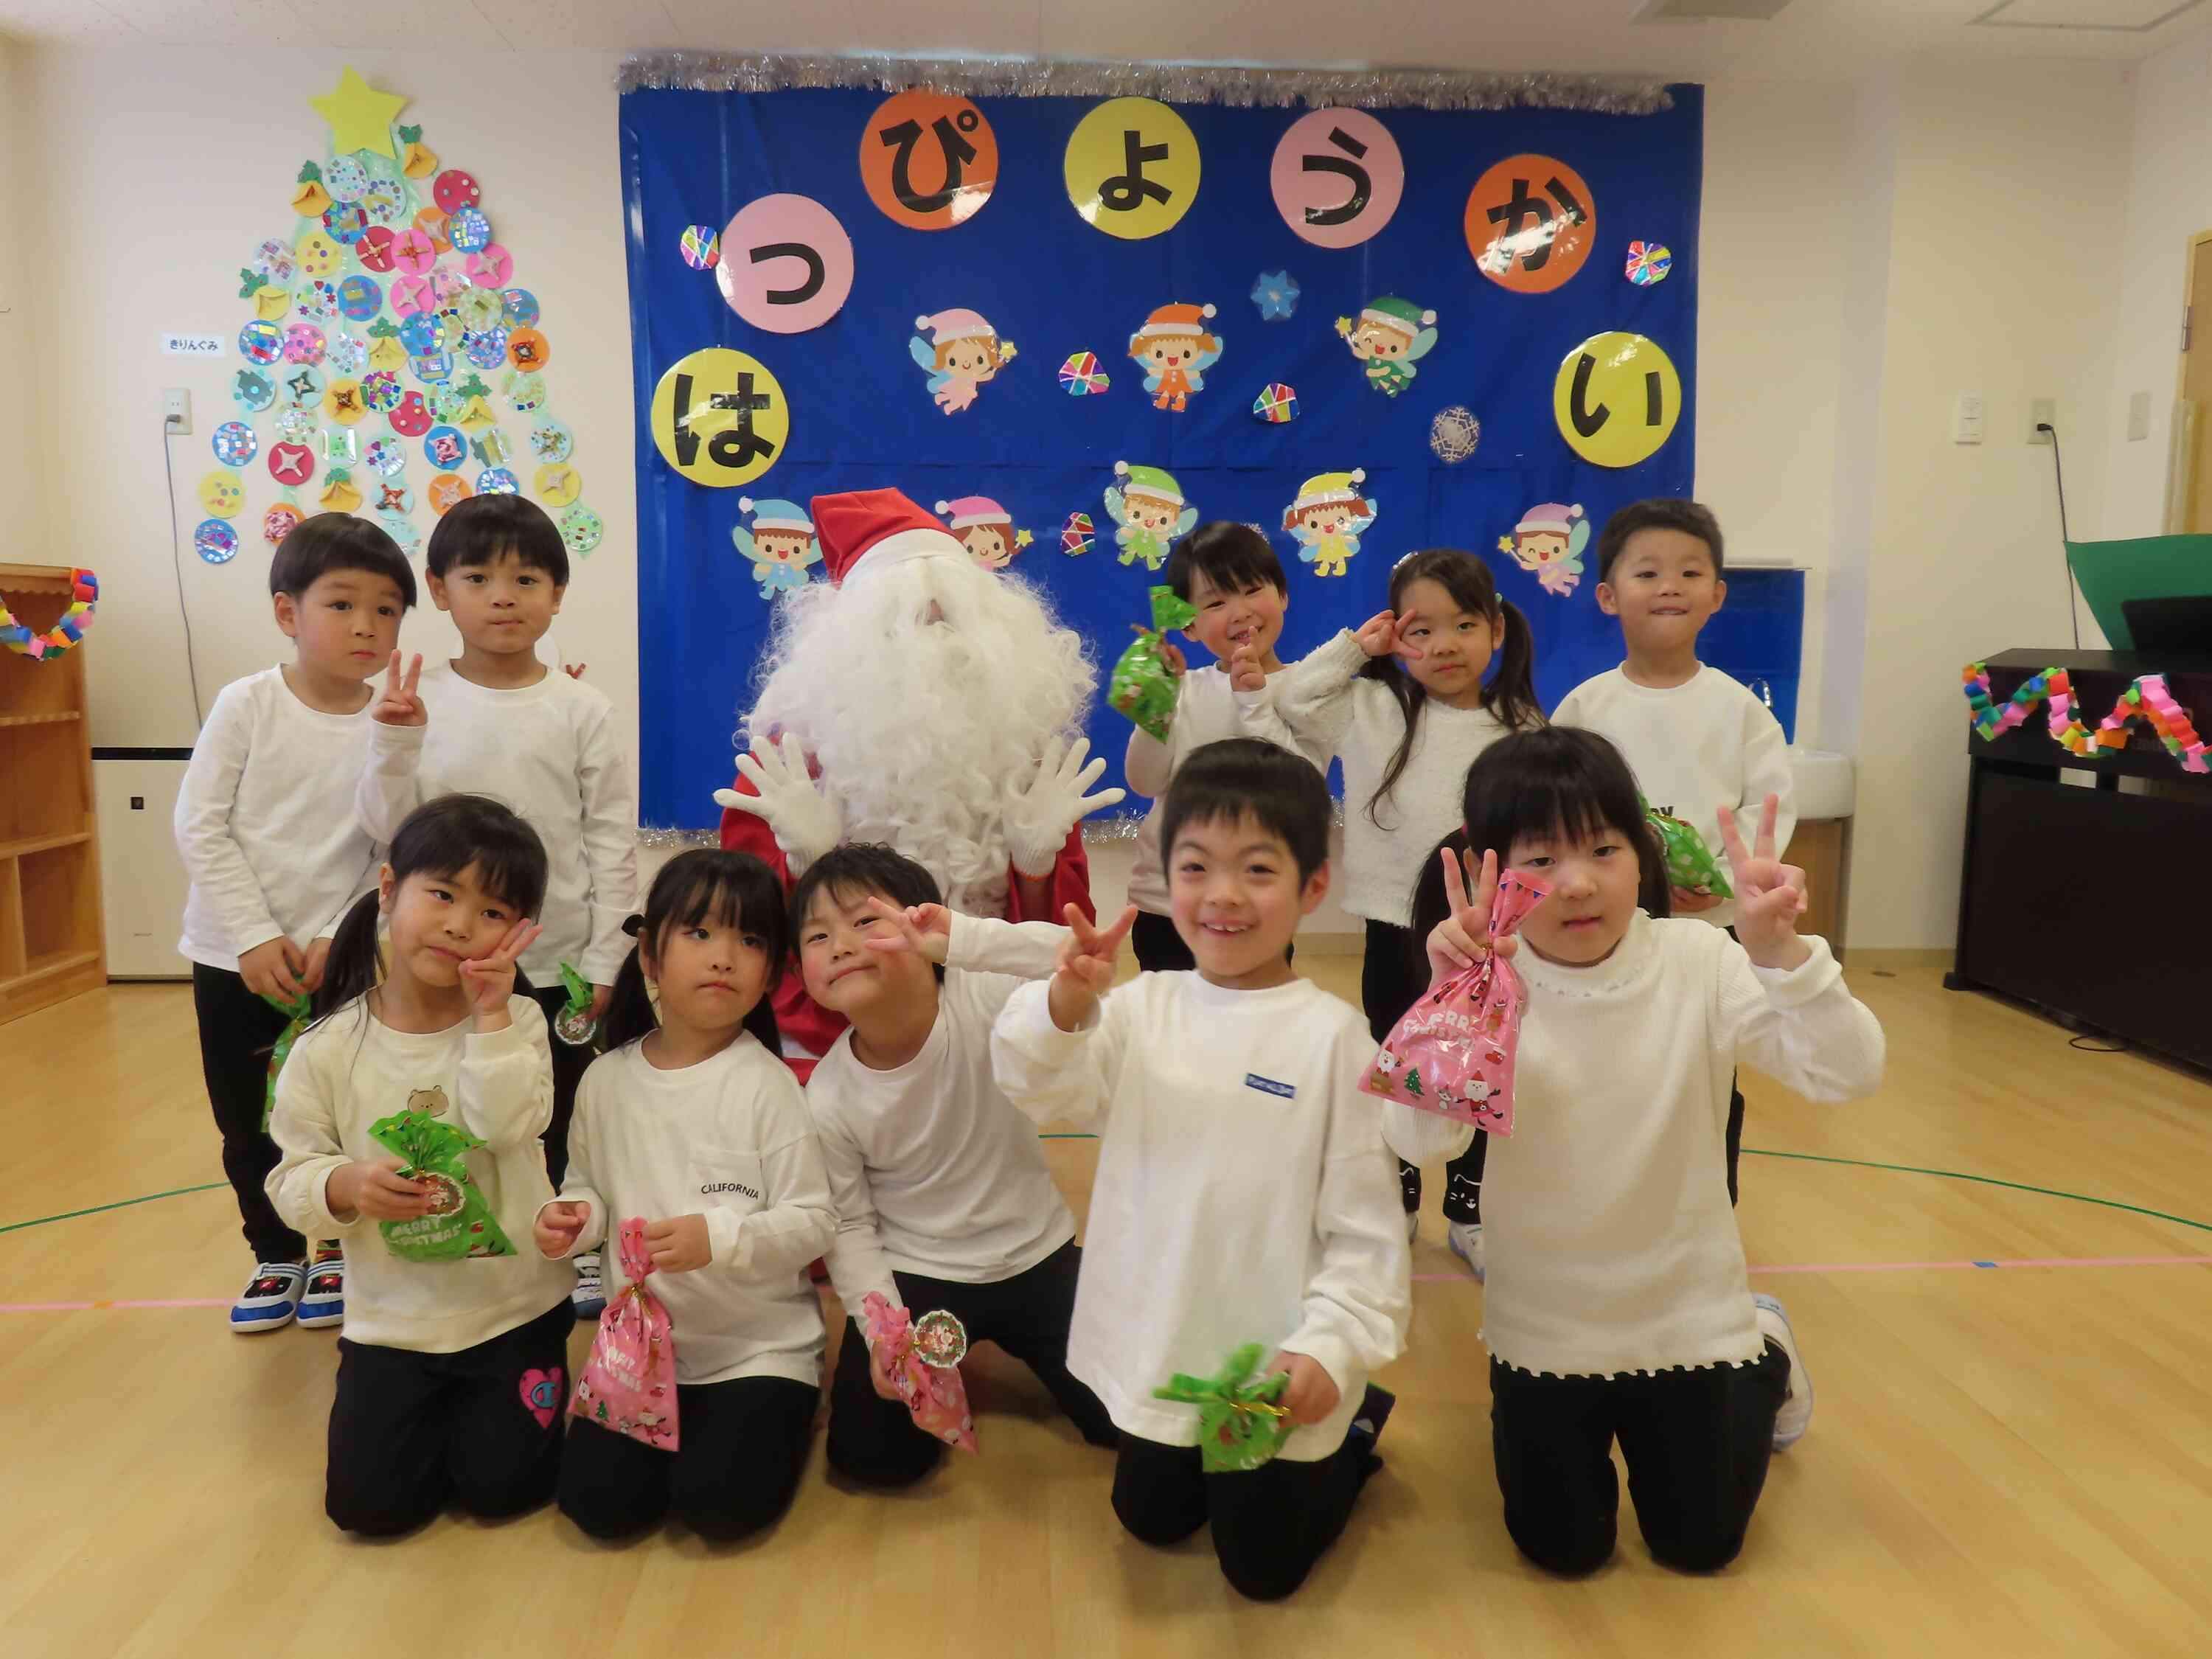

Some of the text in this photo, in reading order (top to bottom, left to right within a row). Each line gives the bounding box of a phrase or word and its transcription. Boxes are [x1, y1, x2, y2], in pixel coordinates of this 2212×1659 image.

[170, 339, 218, 351] きりんぐみ
[700, 1183, 759, 1200] CALIFORNIA
